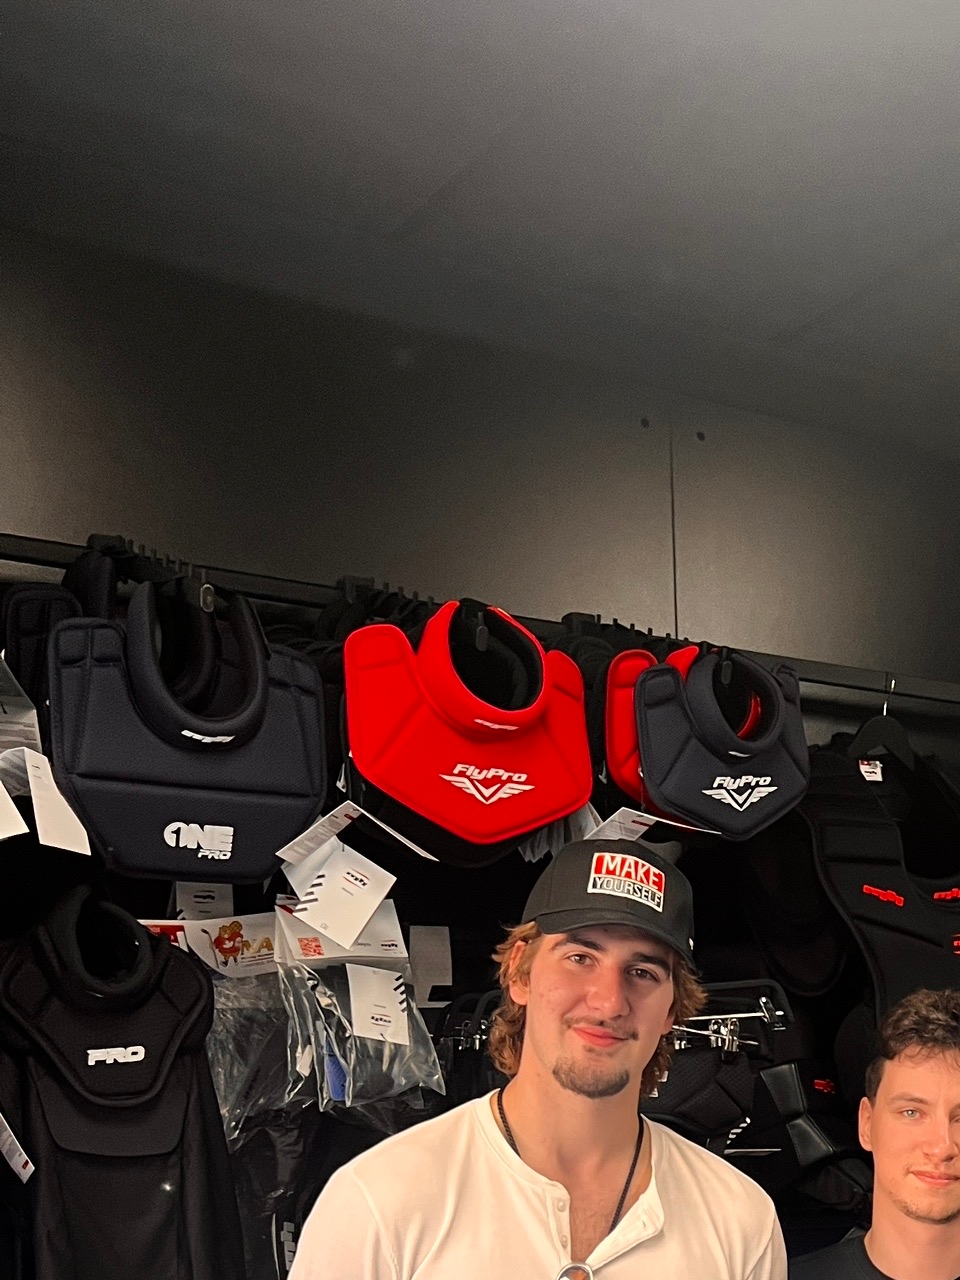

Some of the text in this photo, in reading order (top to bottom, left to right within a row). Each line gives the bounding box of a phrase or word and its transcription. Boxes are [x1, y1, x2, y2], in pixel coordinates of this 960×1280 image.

[452, 763, 528, 782] FlyPro
[712, 775, 772, 790] FlyPro
[197, 849, 232, 860] PRO
[601, 855, 659, 890] MAKE
[595, 876, 661, 905] YOURSELF
[86, 1045, 146, 1066] PRO
